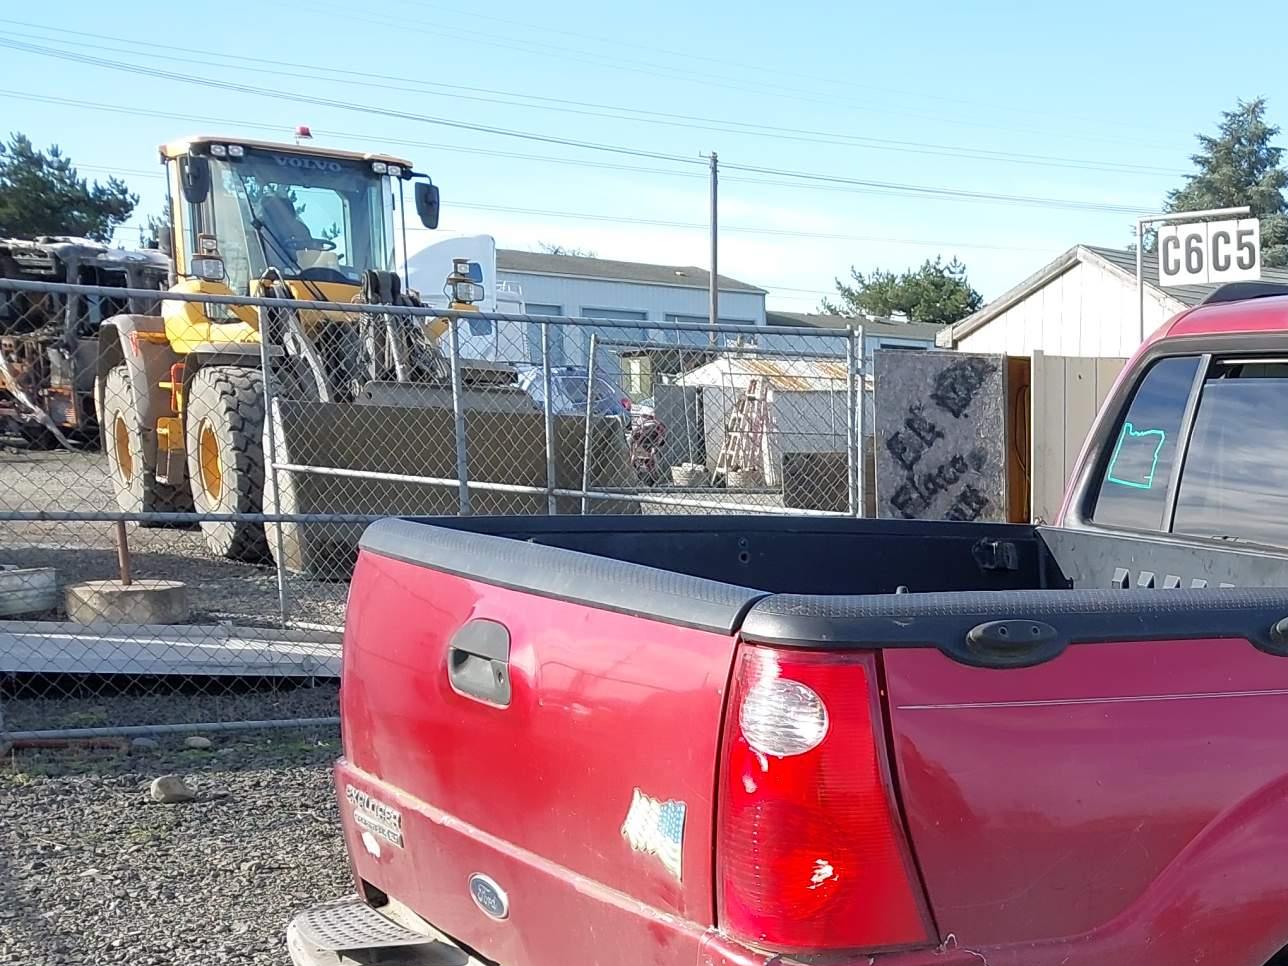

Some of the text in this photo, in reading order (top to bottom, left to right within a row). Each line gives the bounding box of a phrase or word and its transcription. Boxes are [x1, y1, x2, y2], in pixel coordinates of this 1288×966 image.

[272, 155, 342, 172] VOLVO
[1162, 229, 1256, 276] C6 C5
